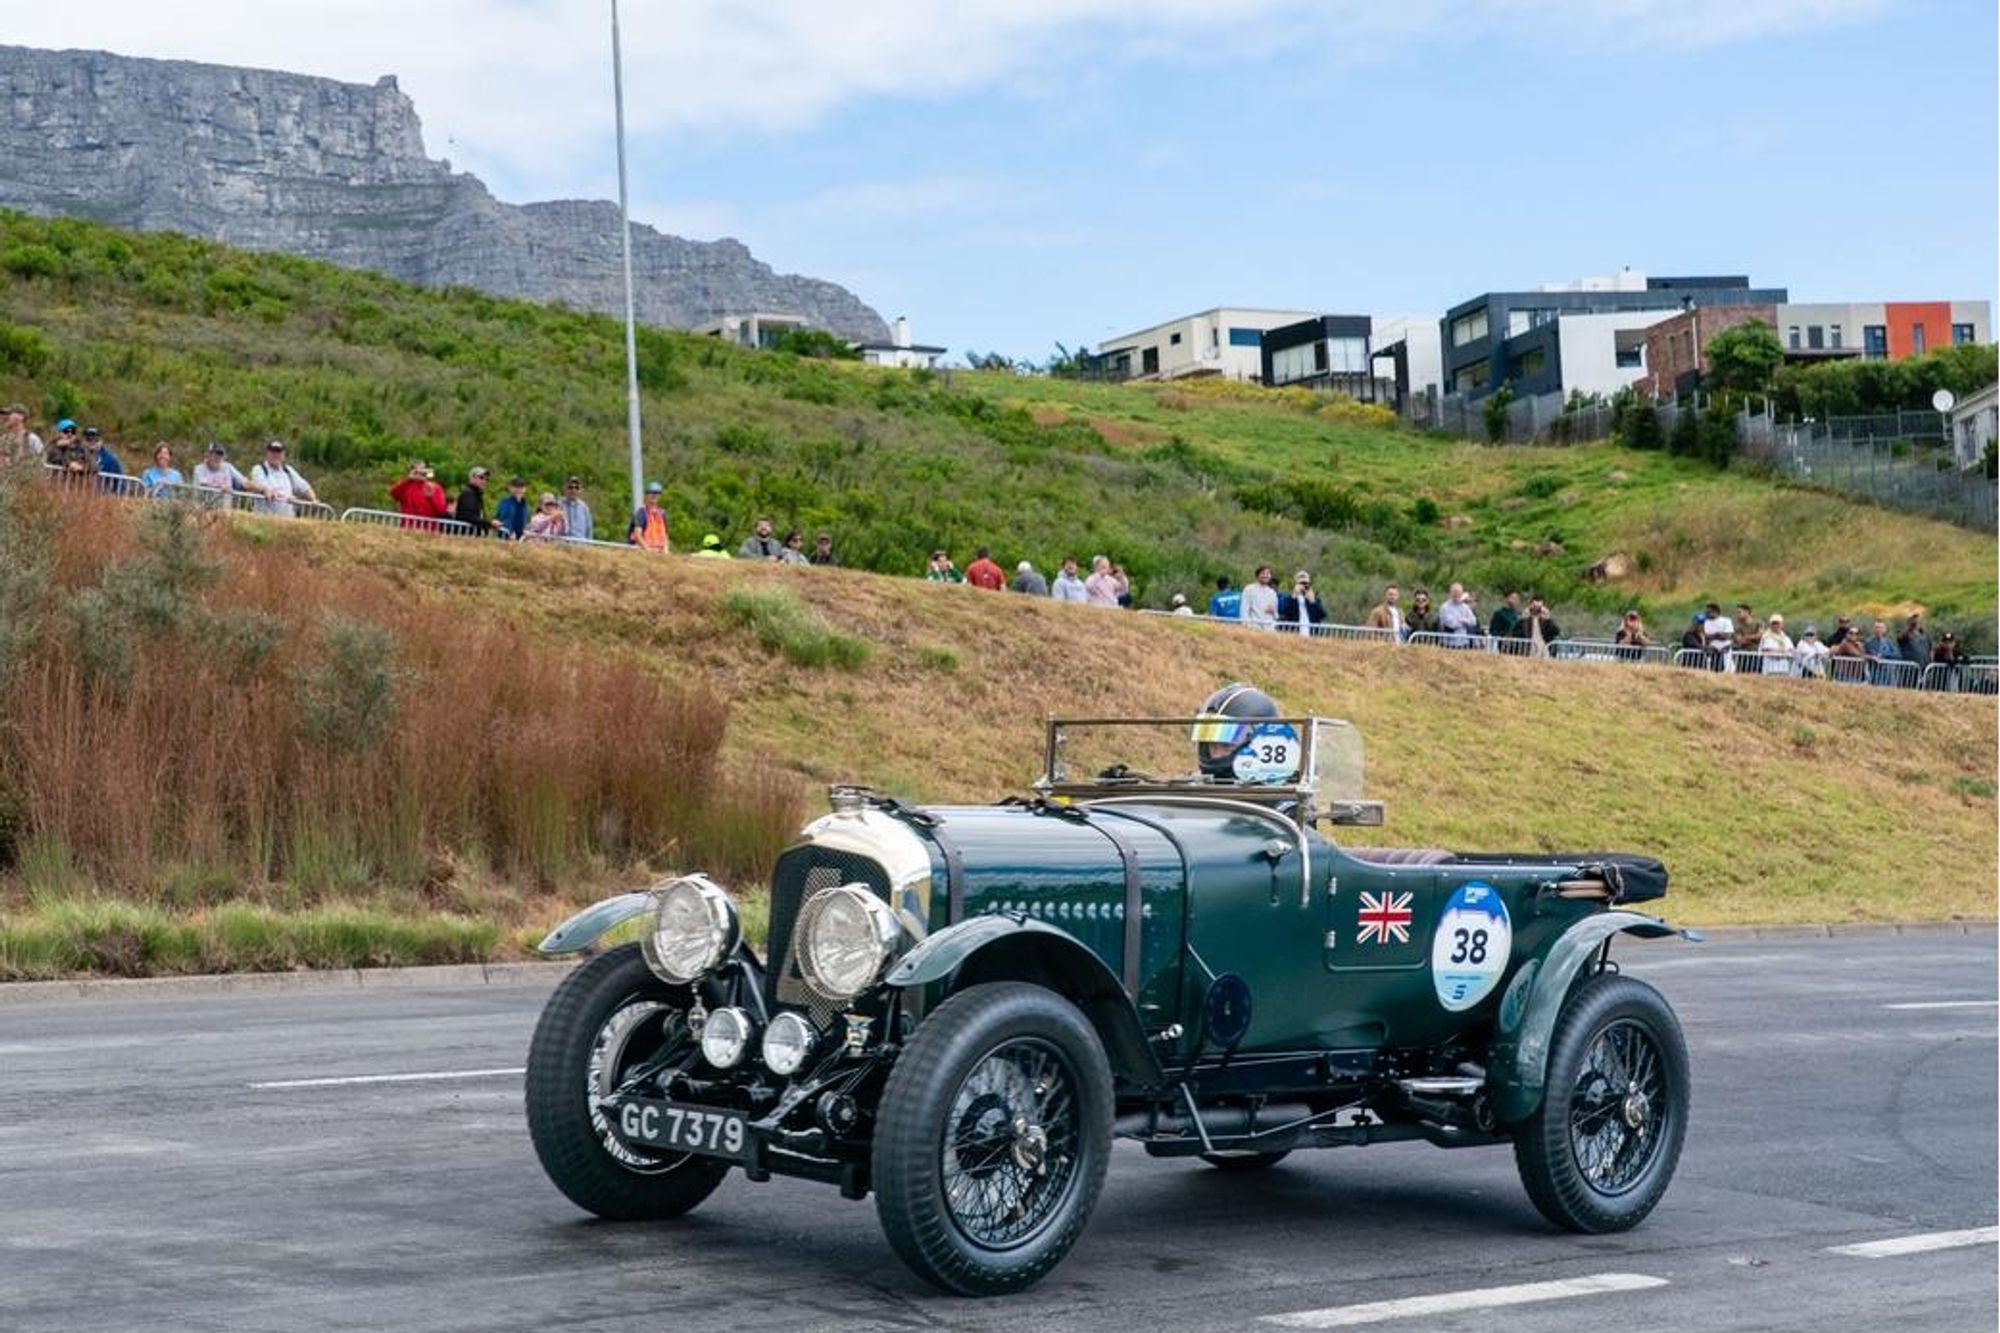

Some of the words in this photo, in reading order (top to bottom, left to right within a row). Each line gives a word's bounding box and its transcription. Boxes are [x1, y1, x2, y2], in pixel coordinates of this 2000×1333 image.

[1260, 744, 1287, 764] 38
[1451, 928, 1489, 965] 38
[621, 1102, 660, 1139] GC
[665, 1108, 744, 1153] 7379
